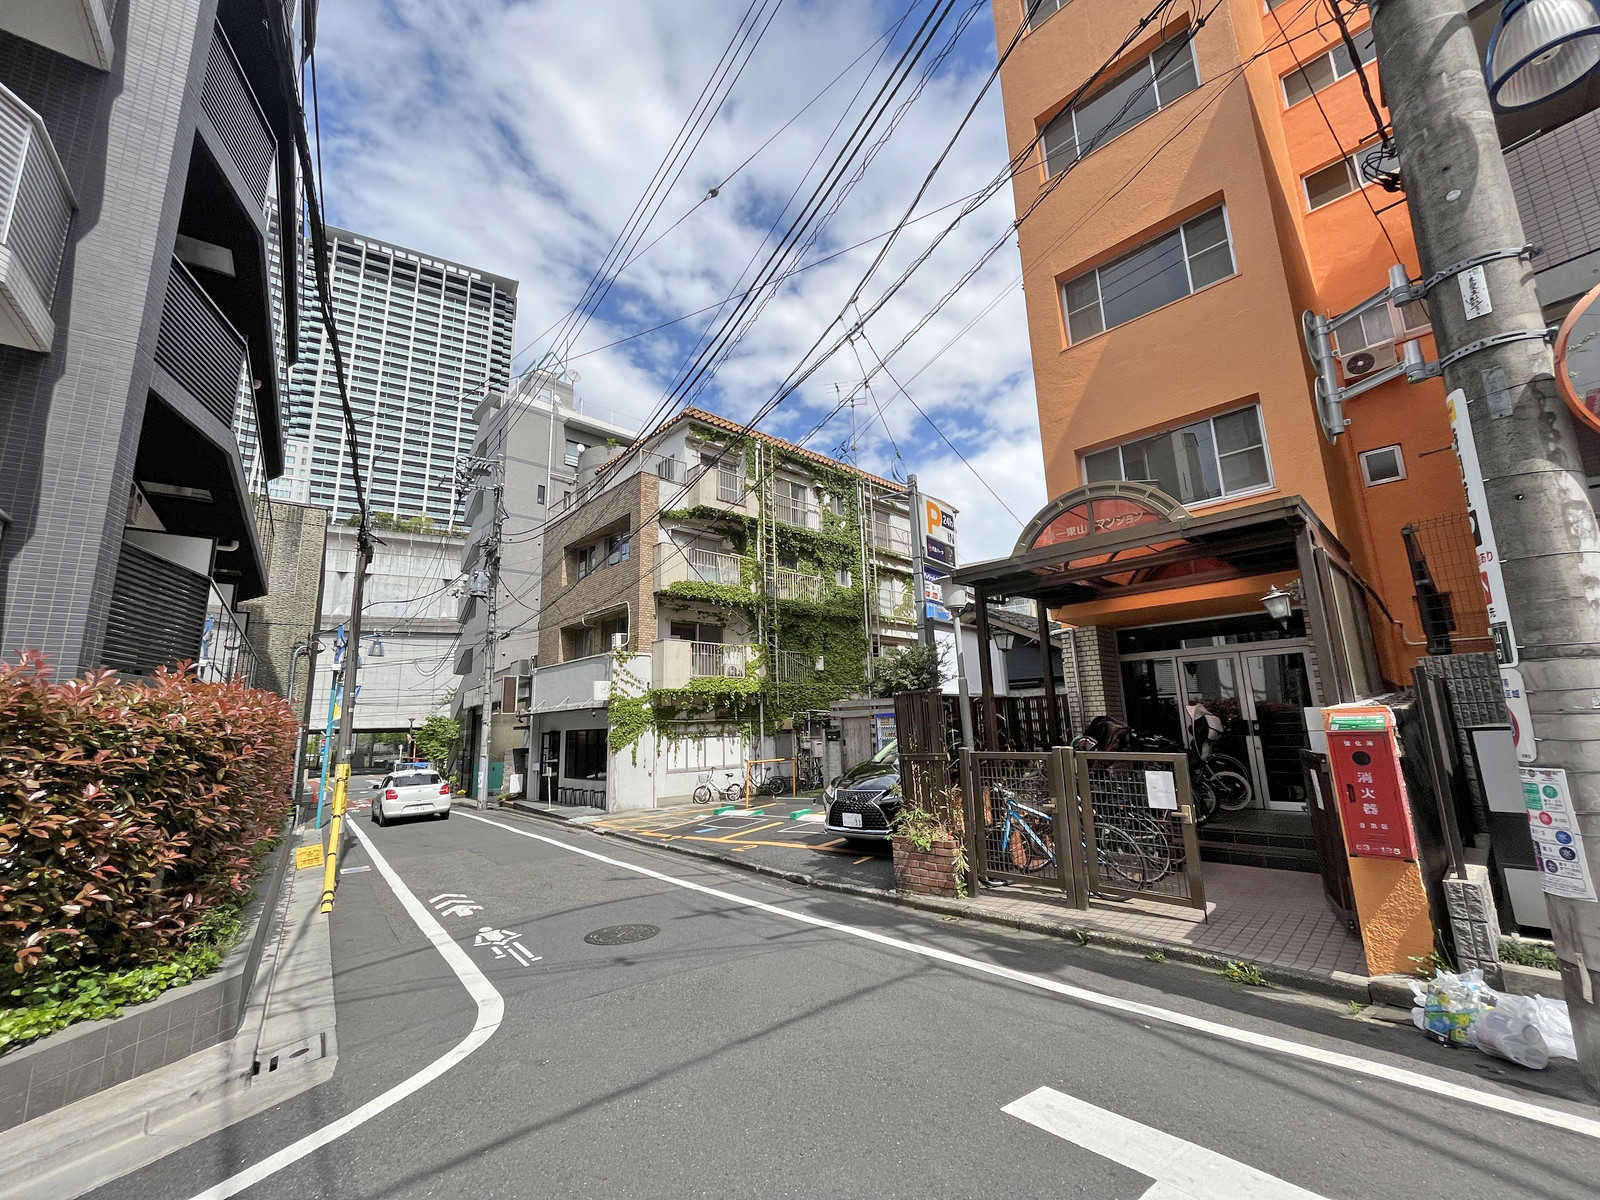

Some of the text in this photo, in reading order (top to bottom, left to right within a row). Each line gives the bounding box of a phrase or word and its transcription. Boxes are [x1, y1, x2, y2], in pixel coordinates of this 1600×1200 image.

[926, 499, 942, 535] P
[1356, 771, 1379, 816] 消火器
